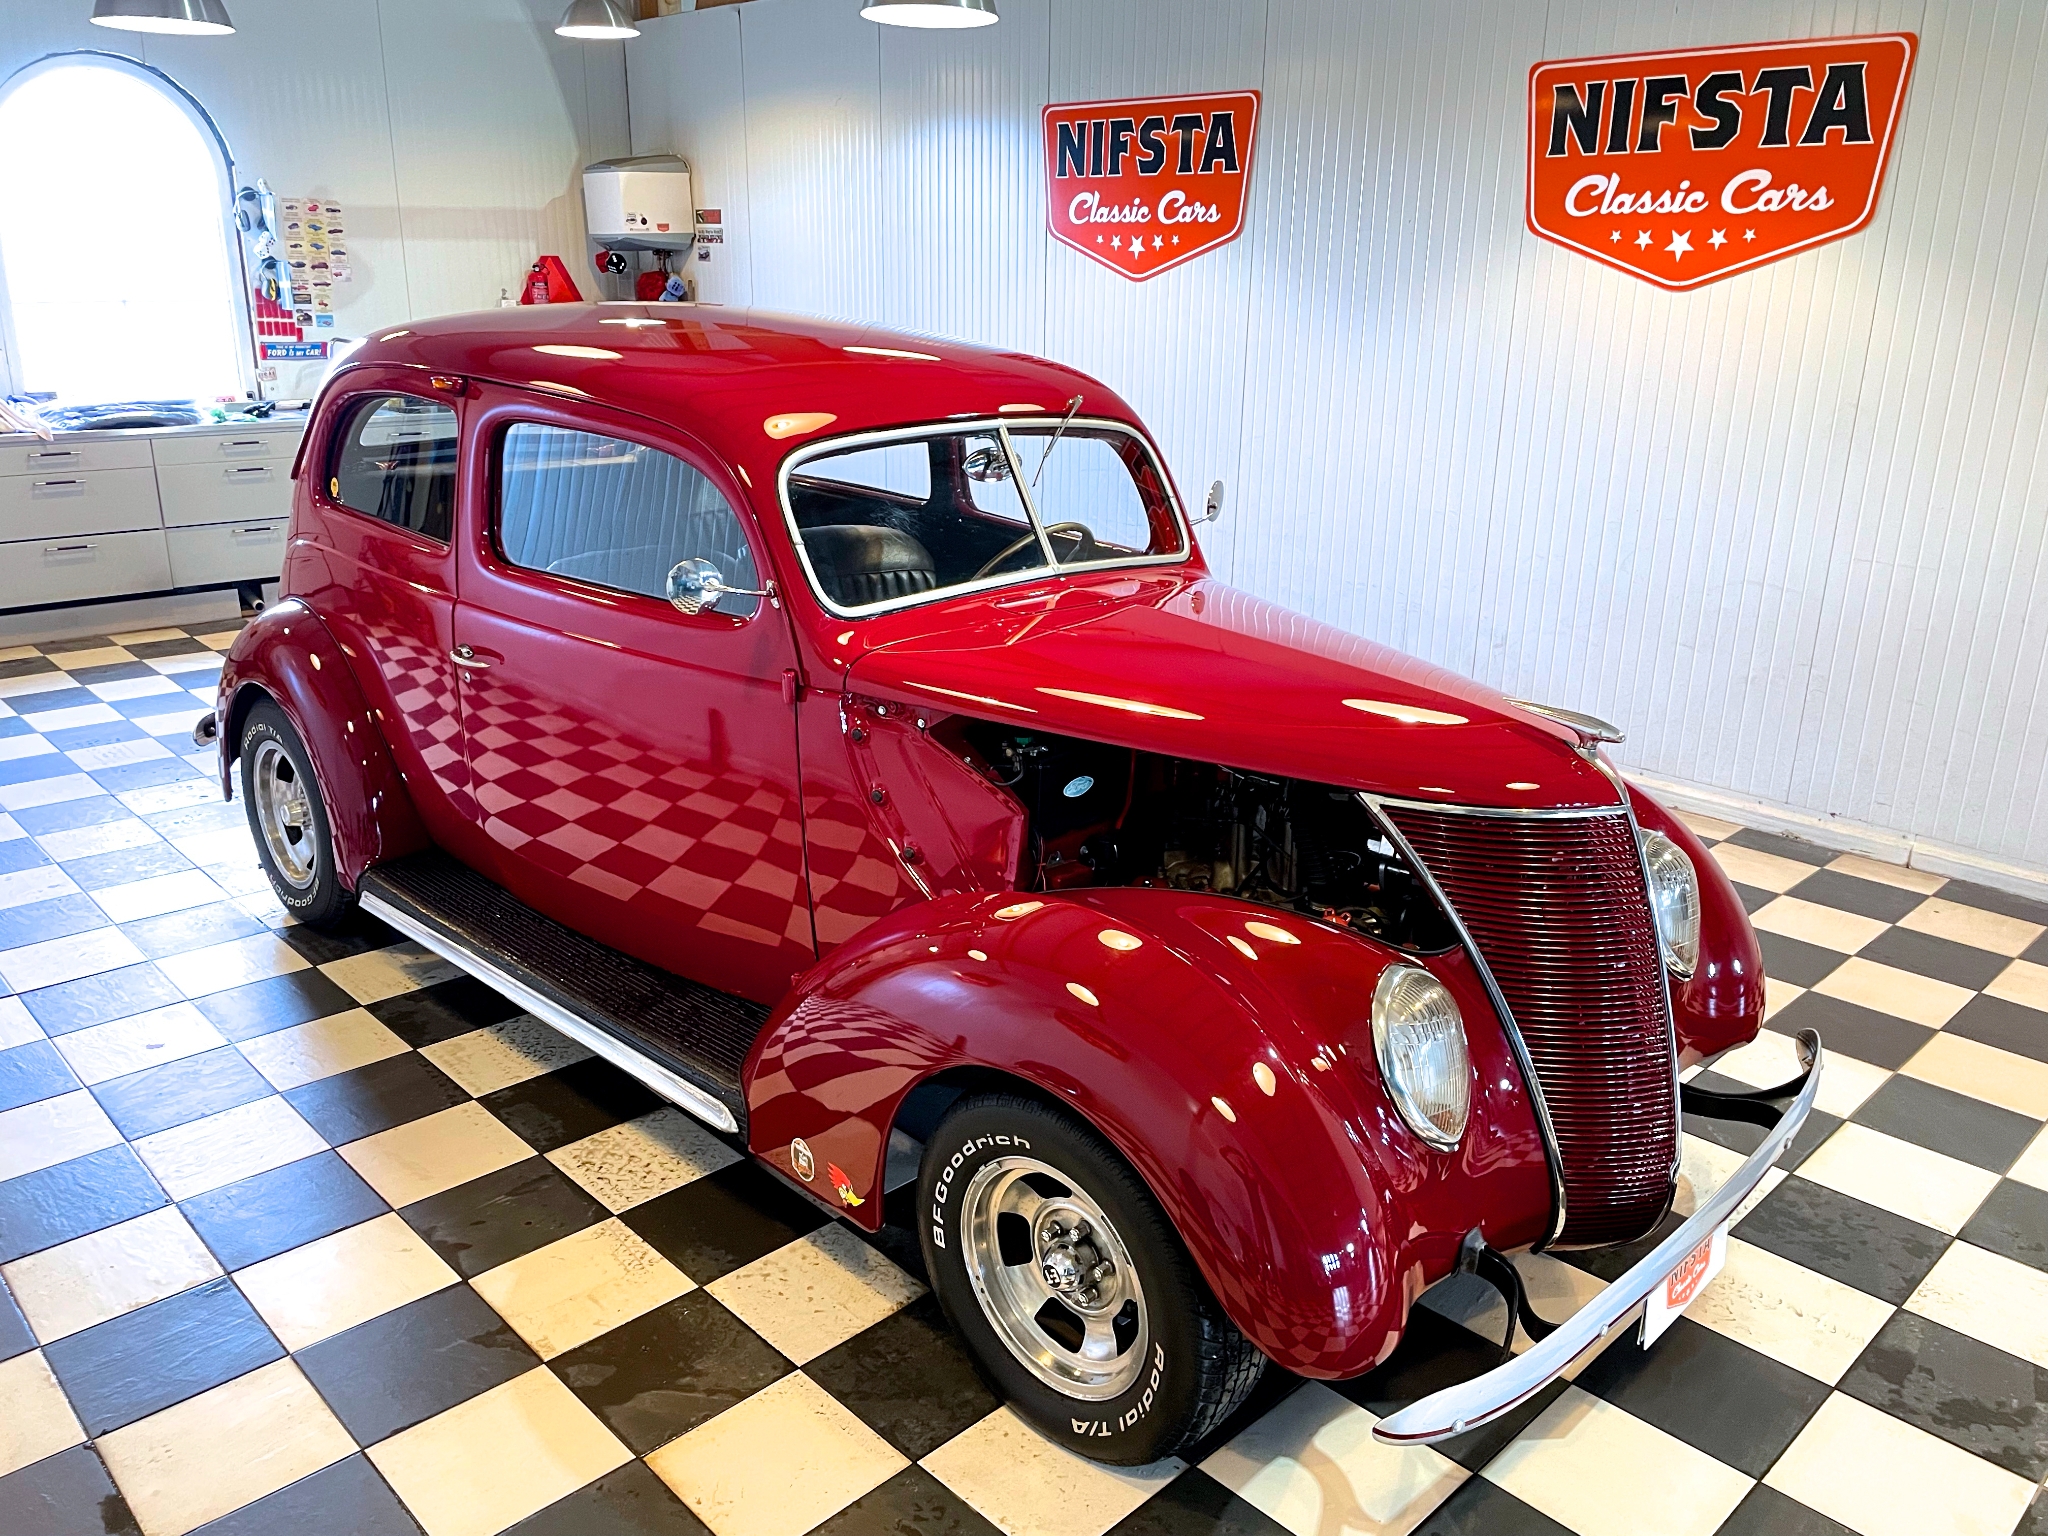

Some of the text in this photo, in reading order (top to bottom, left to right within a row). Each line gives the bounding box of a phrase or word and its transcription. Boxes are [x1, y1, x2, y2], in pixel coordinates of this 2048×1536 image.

[1056, 111, 1240, 178] NIFSTA
[1545, 61, 1874, 157] NIFSTA
[1068, 189, 1221, 225] Classic Cars
[1565, 168, 1834, 217] Classic Cars
[932, 1133, 1031, 1249] BFGoodrich
[1071, 1342, 1165, 1438] Radial T/A
